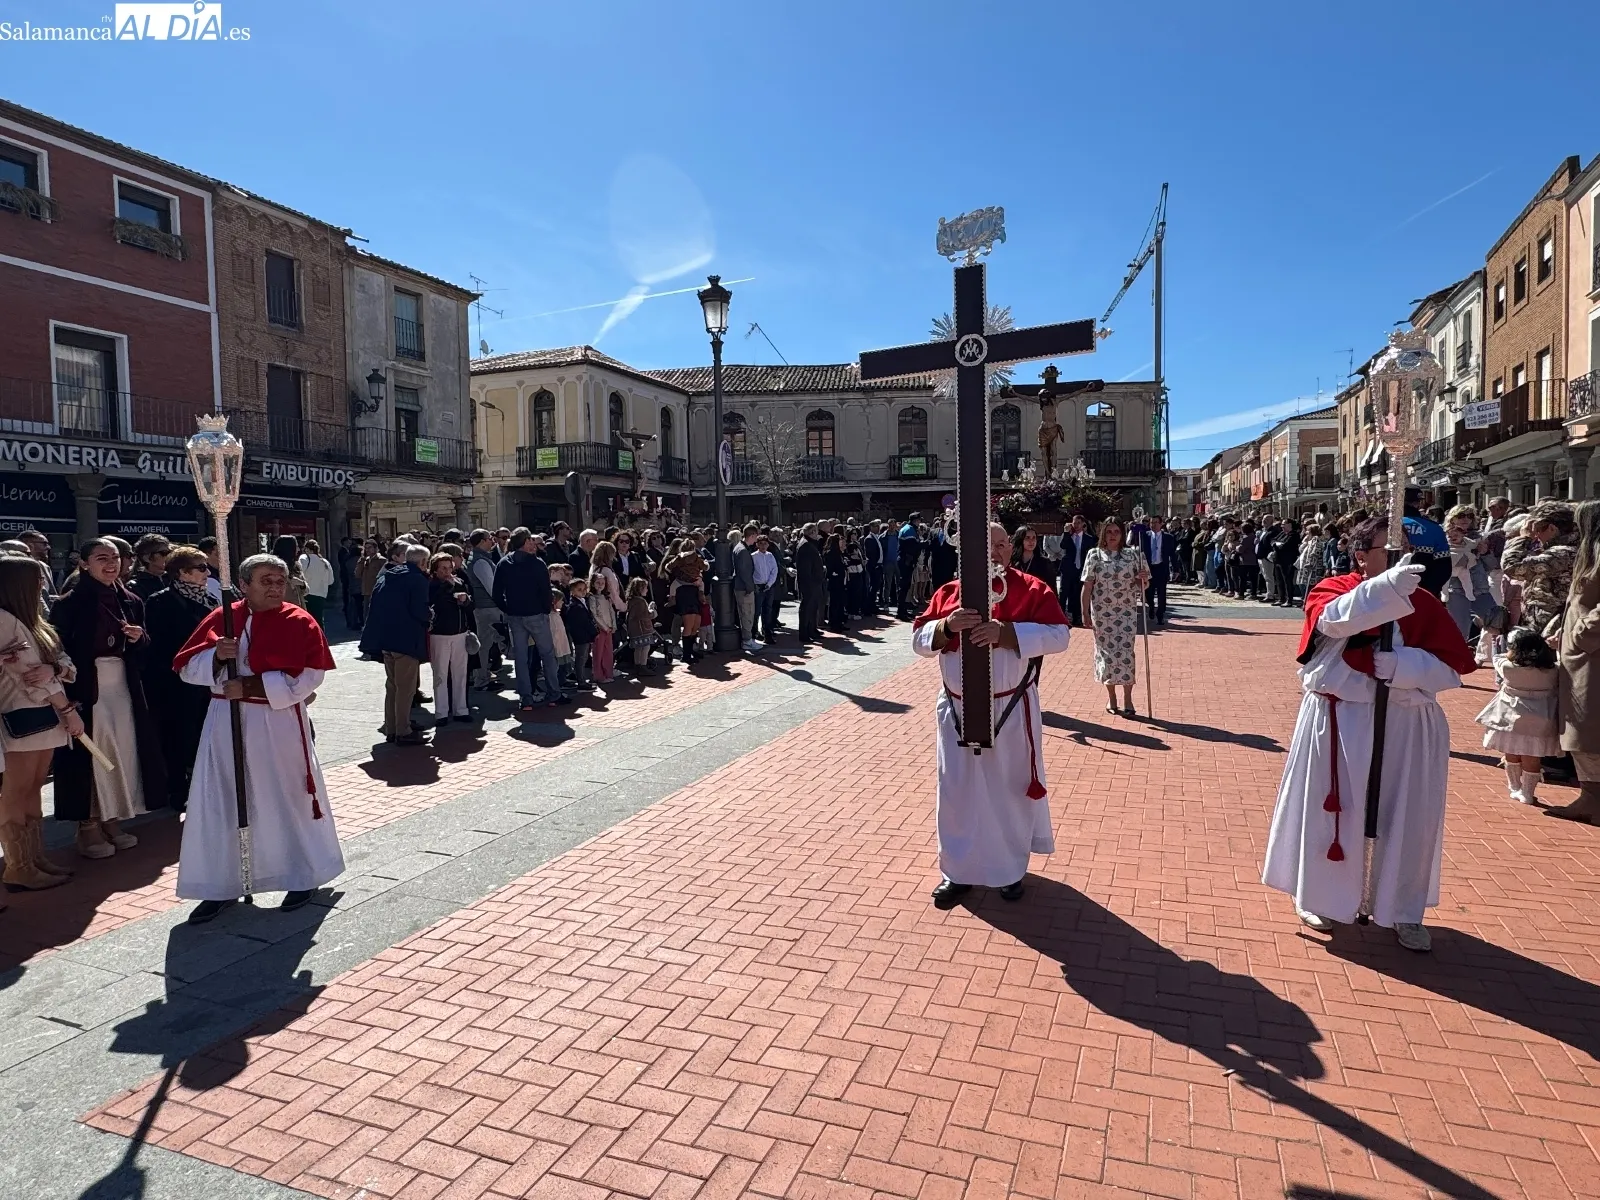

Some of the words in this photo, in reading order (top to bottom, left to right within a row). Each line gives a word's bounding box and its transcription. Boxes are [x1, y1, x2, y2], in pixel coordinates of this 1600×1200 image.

[137, 451, 191, 475] Guill
[262, 462, 356, 486] EMBUTIDOS
[0, 483, 57, 502] lermo
[97, 483, 188, 513] Guillermo
[246, 499, 294, 509] CHARCUTERÍA
[117, 524, 170, 534] JAMONERÍA
